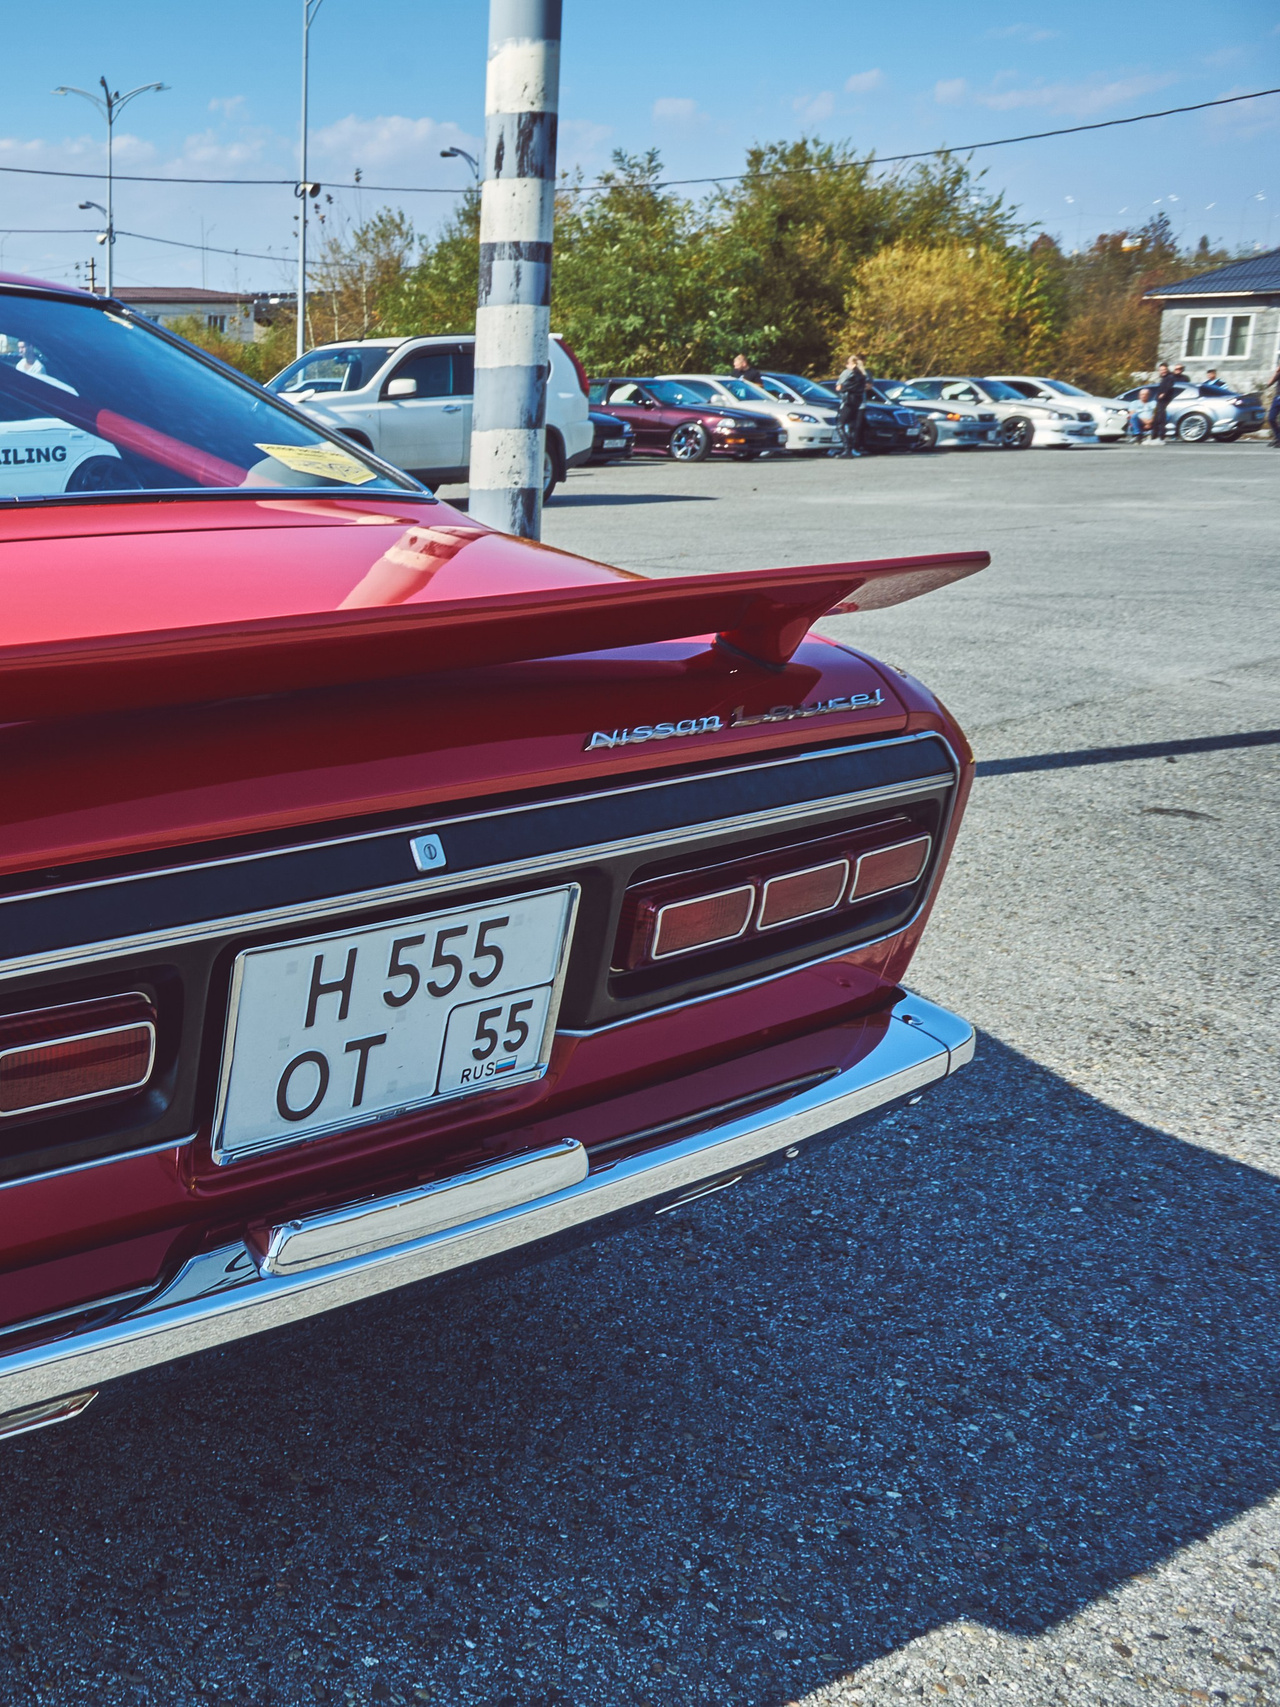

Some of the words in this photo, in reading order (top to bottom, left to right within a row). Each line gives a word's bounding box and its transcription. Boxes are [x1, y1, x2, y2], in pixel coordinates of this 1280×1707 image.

[582, 714, 724, 751] Nissan
[730, 688, 886, 728] Laurel
[383, 915, 510, 1007] 555
[472, 999, 534, 1061] 55
[276, 1032, 387, 1122] OT
[460, 1061, 495, 1084] RUS
